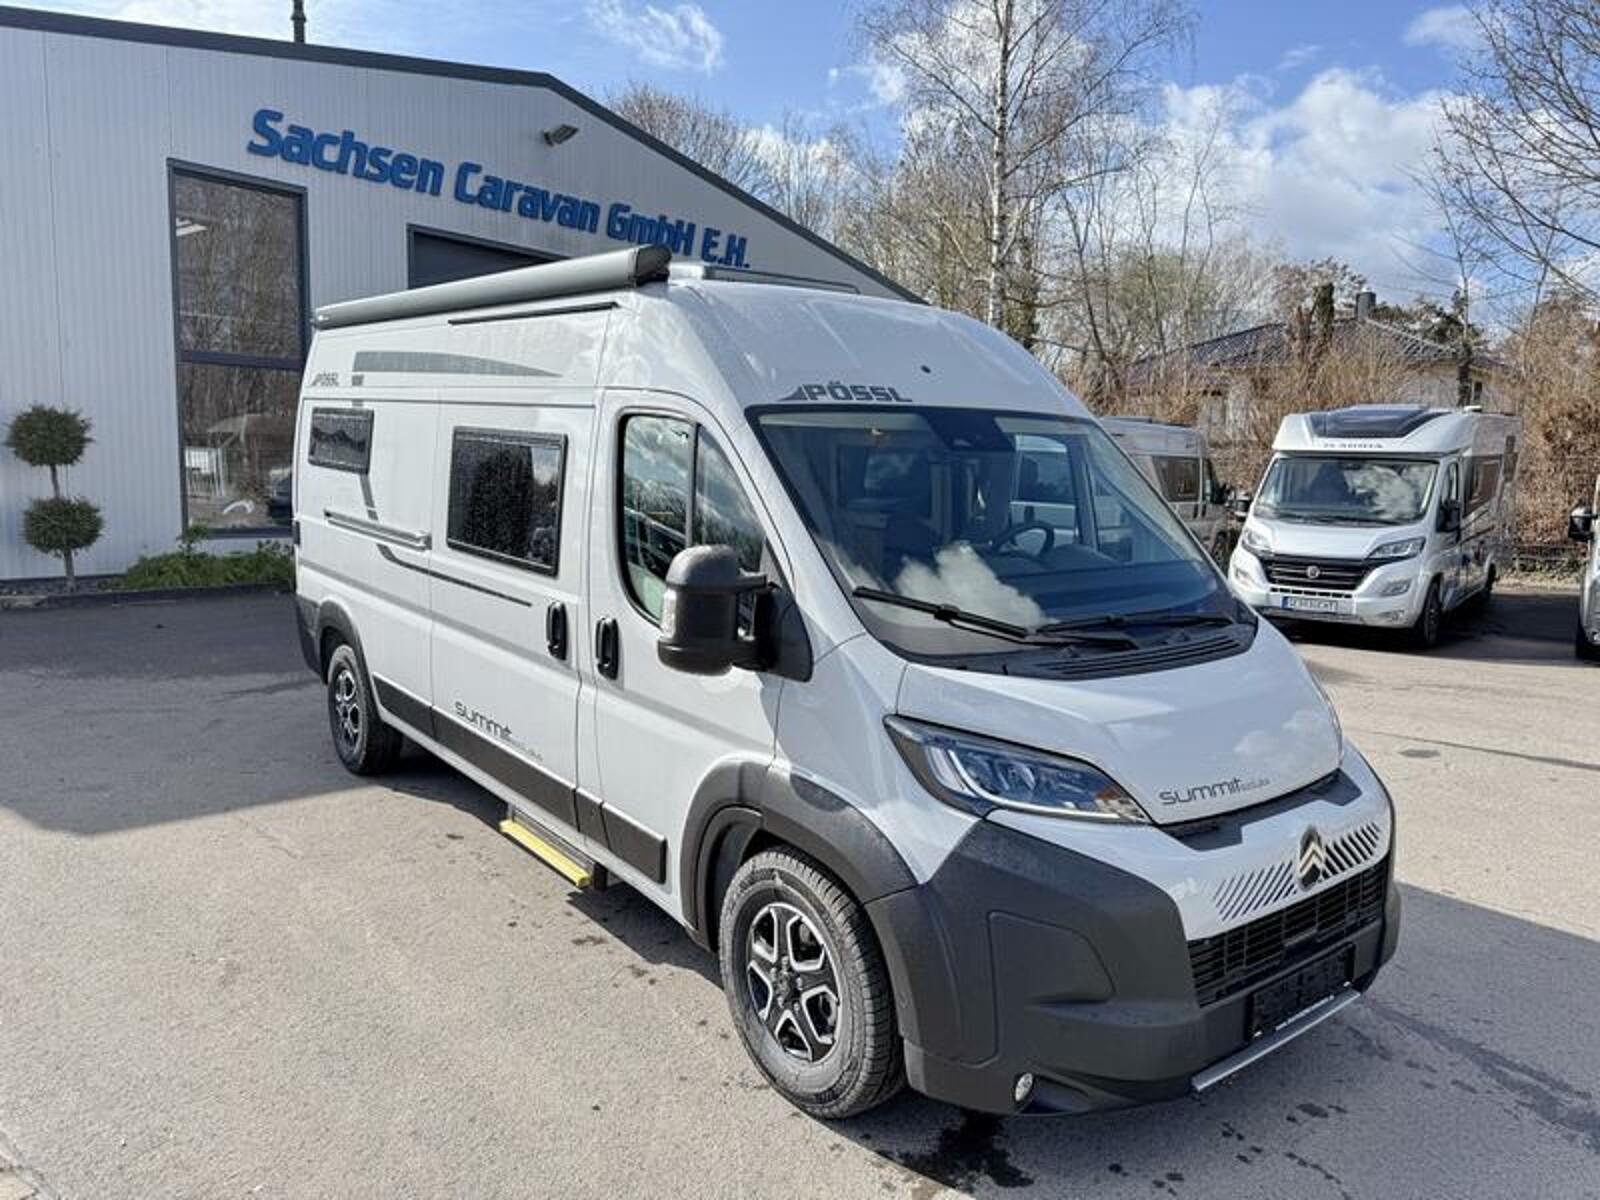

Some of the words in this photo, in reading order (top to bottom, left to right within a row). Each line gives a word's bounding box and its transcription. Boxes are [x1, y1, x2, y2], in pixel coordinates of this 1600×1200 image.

[247, 108, 445, 197] Sachsen
[454, 161, 600, 233] Caravan
[607, 203, 697, 256] GmbH
[702, 227, 750, 268] E.H.
[779, 380, 913, 403] PÖSSL
